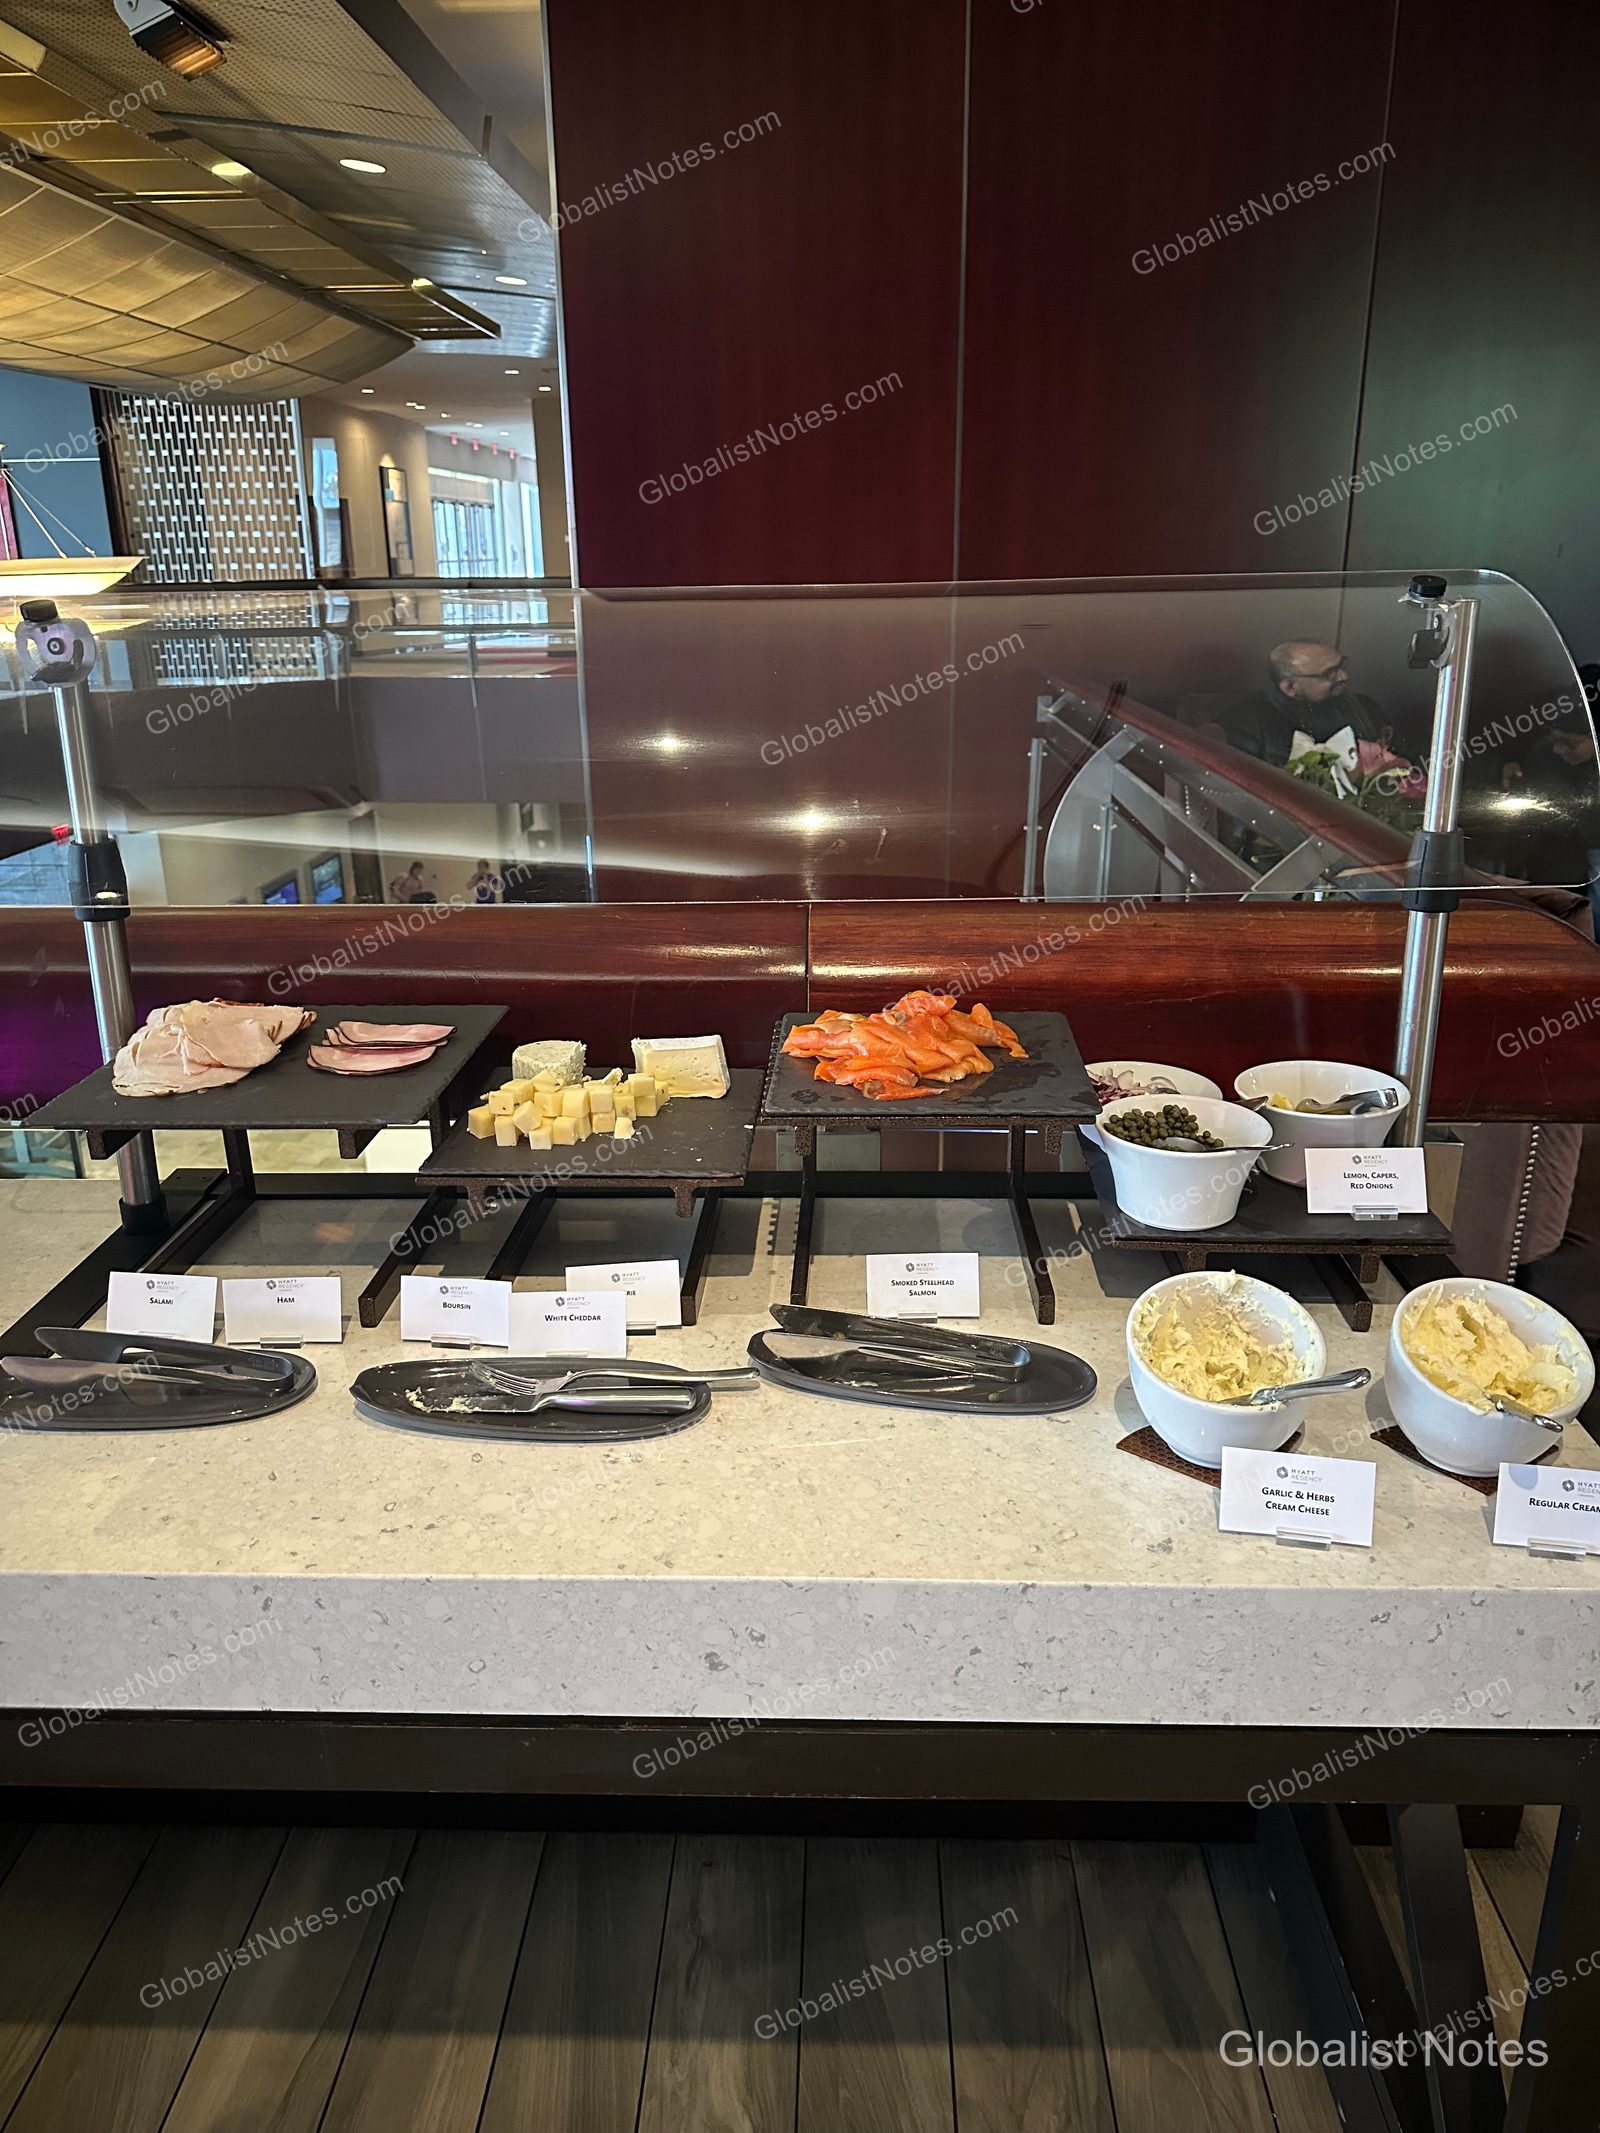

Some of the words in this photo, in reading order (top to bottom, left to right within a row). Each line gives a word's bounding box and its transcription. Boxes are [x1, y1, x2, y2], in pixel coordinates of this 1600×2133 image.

[1291, 1474, 1322, 1482] REGENCY
[1261, 1486, 1293, 1498] GARLIC
[1295, 1490, 1304, 1499] &
[1306, 1491, 1335, 1503] HERBS
[1265, 1501, 1296, 1512] CREAM
[1298, 1504, 1330, 1516] CHEESE
[1529, 1498, 1570, 1509] REGULAR
